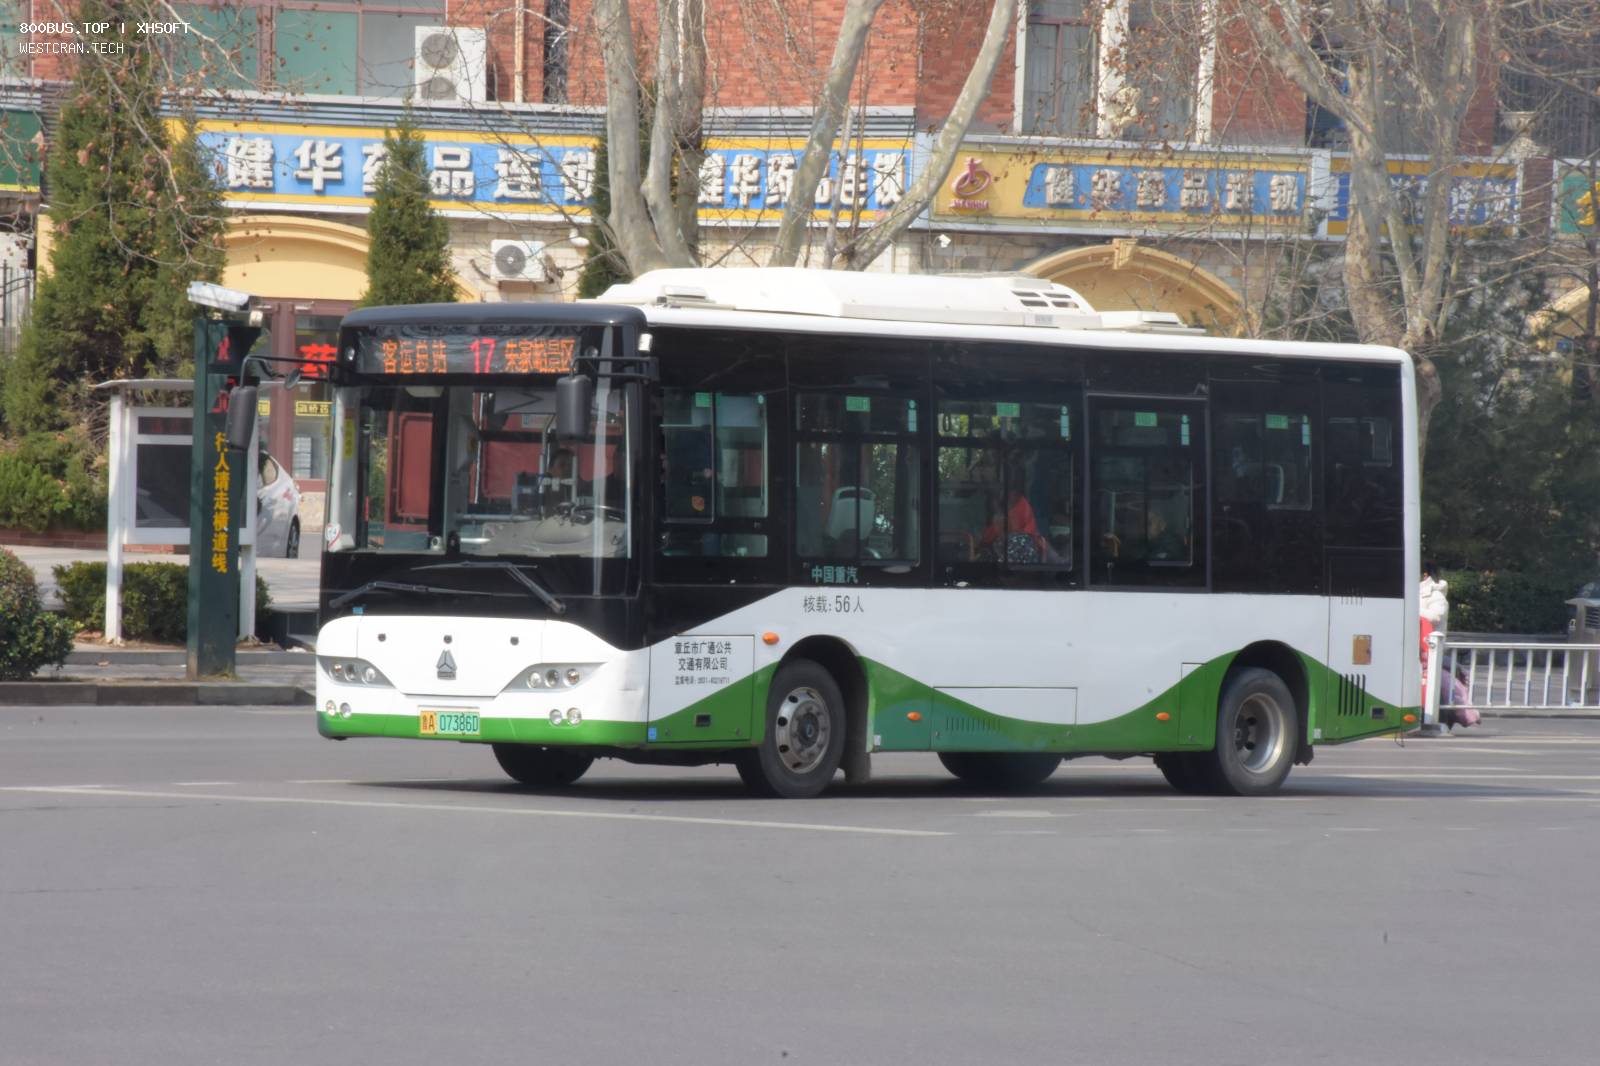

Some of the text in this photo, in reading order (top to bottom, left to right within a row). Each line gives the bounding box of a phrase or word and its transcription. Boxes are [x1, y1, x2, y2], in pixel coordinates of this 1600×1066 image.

[469, 337, 496, 375] 17
[810, 564, 859, 584] 中国重汽
[674, 641, 732, 655] 章丘市广通公共
[678, 656, 728, 671] 交通有限公司
